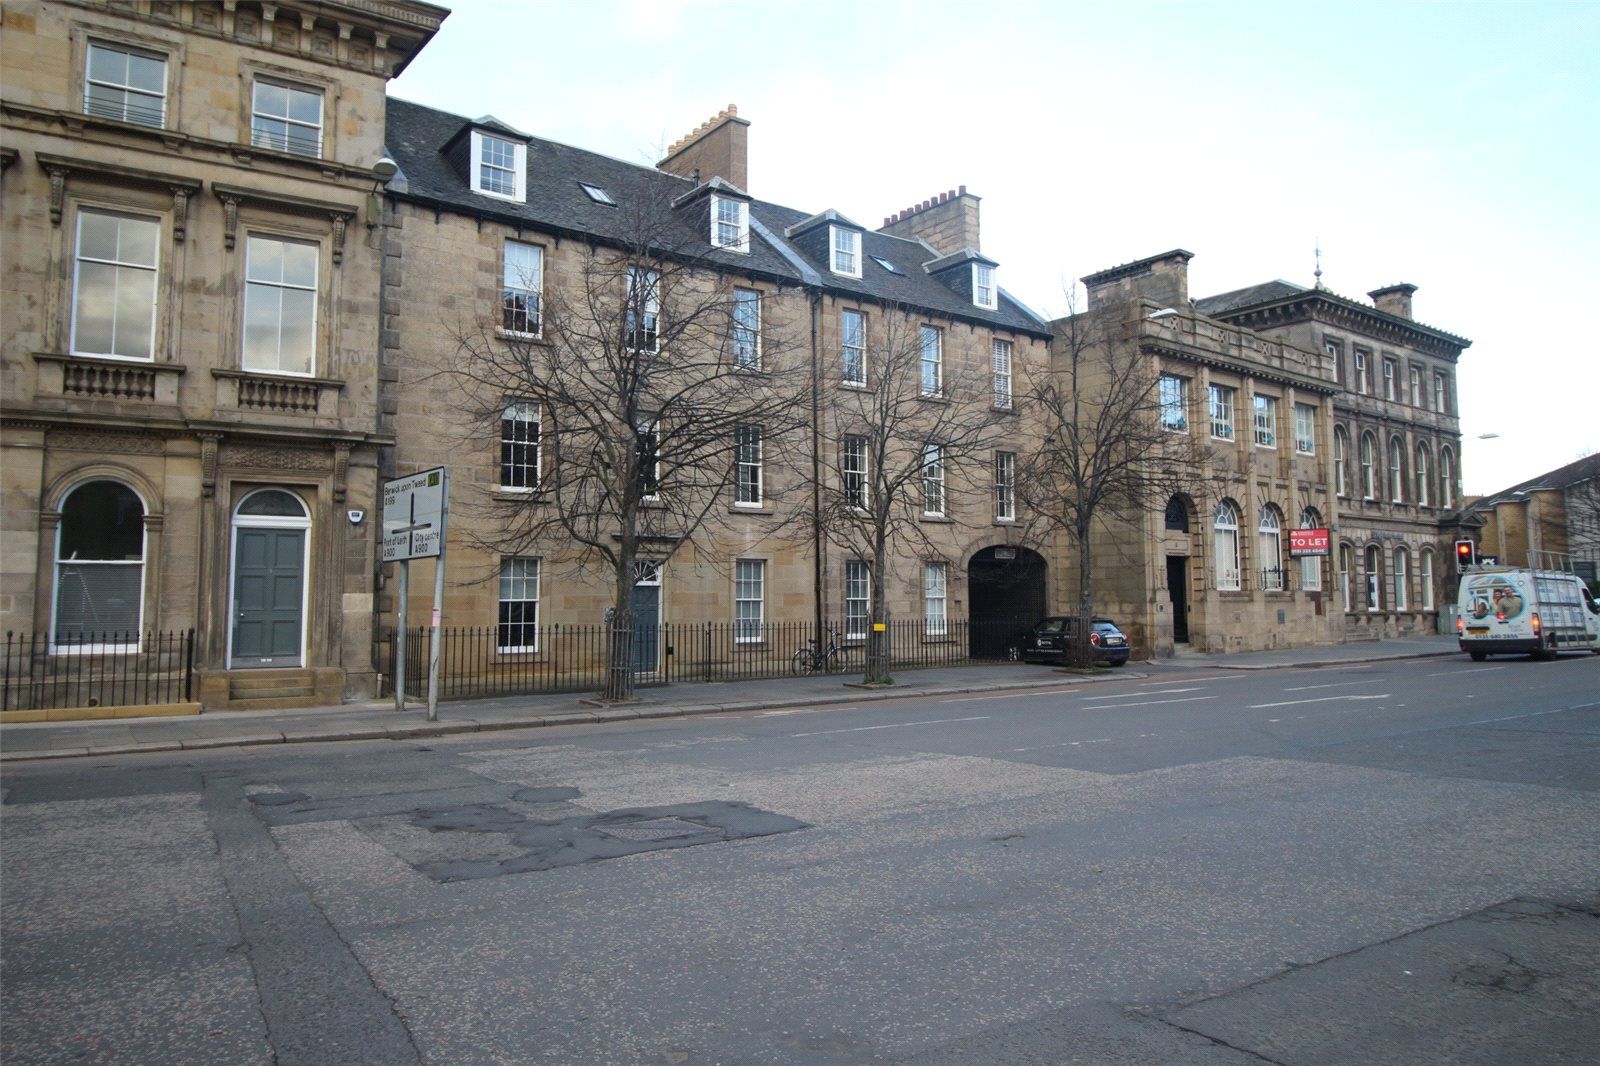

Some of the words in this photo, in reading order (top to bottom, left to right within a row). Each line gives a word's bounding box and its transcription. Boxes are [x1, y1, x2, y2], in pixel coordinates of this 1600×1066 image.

[385, 484, 400, 496] Berwick
[401, 482, 412, 493] upon
[412, 478, 426, 488] Tweed
[384, 537, 392, 546] Port
[397, 535, 407, 544] Leith
[415, 533, 424, 543] City
[425, 531, 439, 541] centre
[1290, 538, 1305, 546] TO
[1308, 537, 1328, 546] LET
